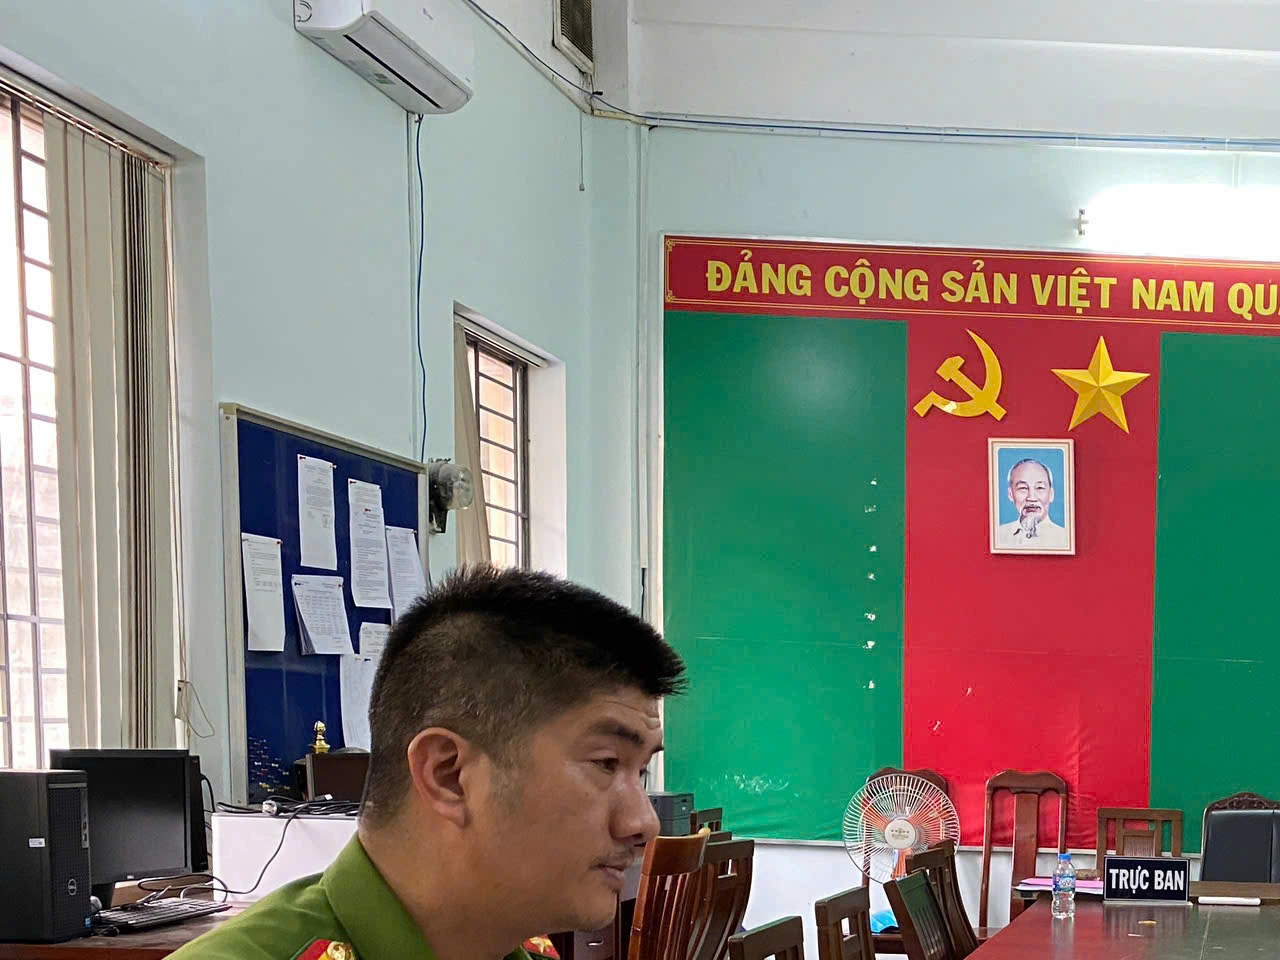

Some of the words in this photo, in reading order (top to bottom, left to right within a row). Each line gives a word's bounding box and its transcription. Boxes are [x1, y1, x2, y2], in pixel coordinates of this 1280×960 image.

[706, 249, 811, 296] ĐẢNG
[825, 259, 928, 305] CỘNG
[941, 260, 1017, 305] SẢN
[1032, 267, 1117, 314] VIỆT
[1133, 280, 1214, 313] NAM
[1109, 865, 1150, 894] TRỰC
[1154, 869, 1185, 891] BAN
